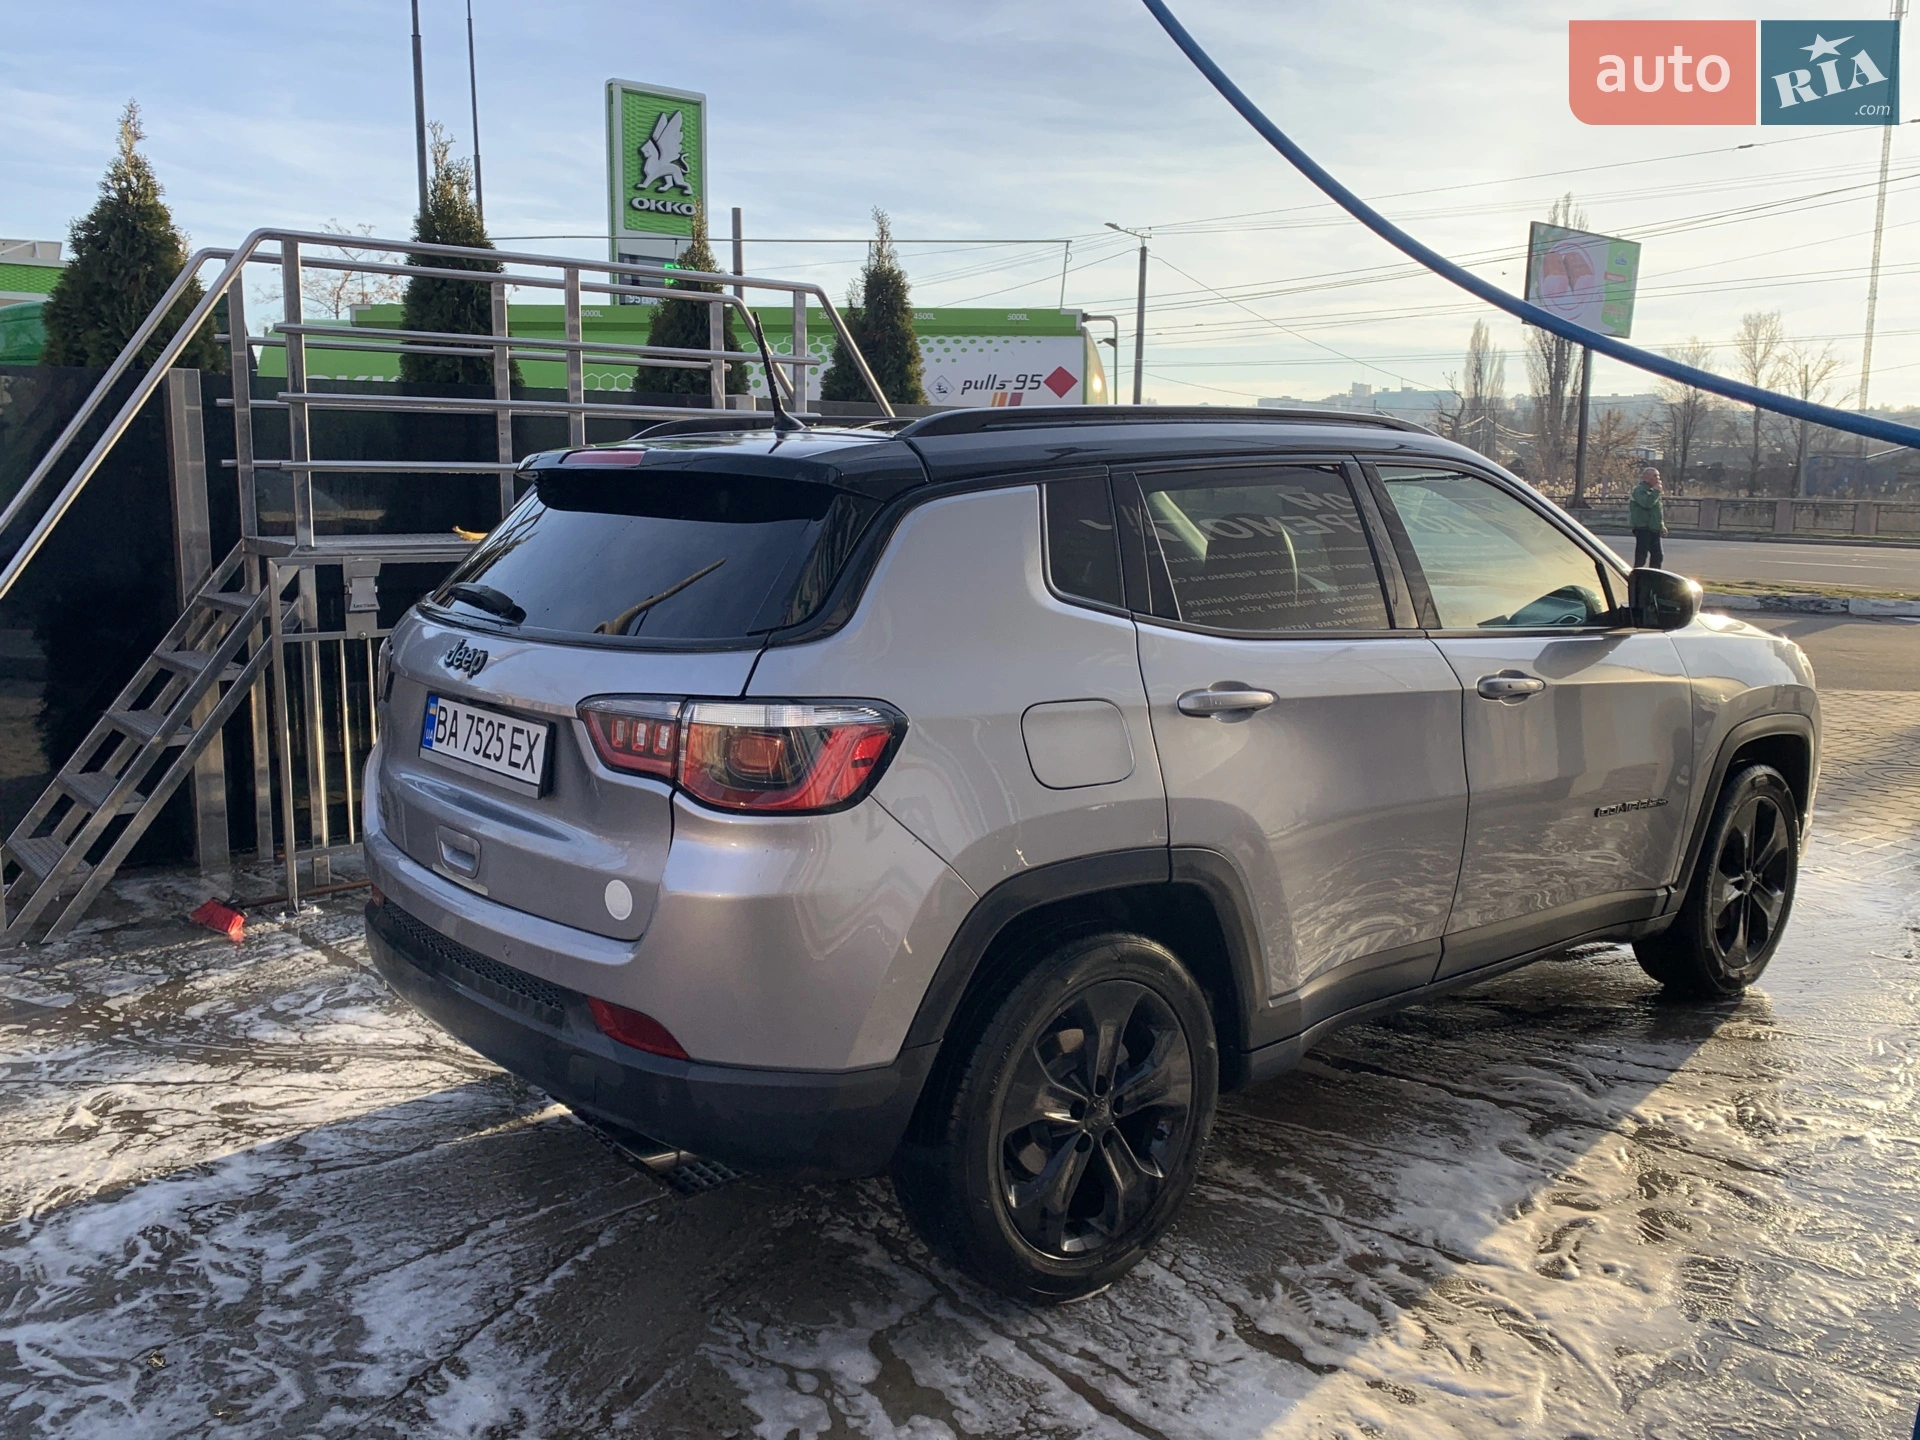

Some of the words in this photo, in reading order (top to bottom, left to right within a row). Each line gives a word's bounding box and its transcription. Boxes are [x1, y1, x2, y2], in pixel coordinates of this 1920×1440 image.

[631, 197, 697, 216] OKKO
[913, 312, 937, 321] 4500L
[444, 638, 489, 679] Jeep
[434, 705, 458, 749] BA
[463, 713, 506, 762] 7525
[507, 726, 541, 774] EX
